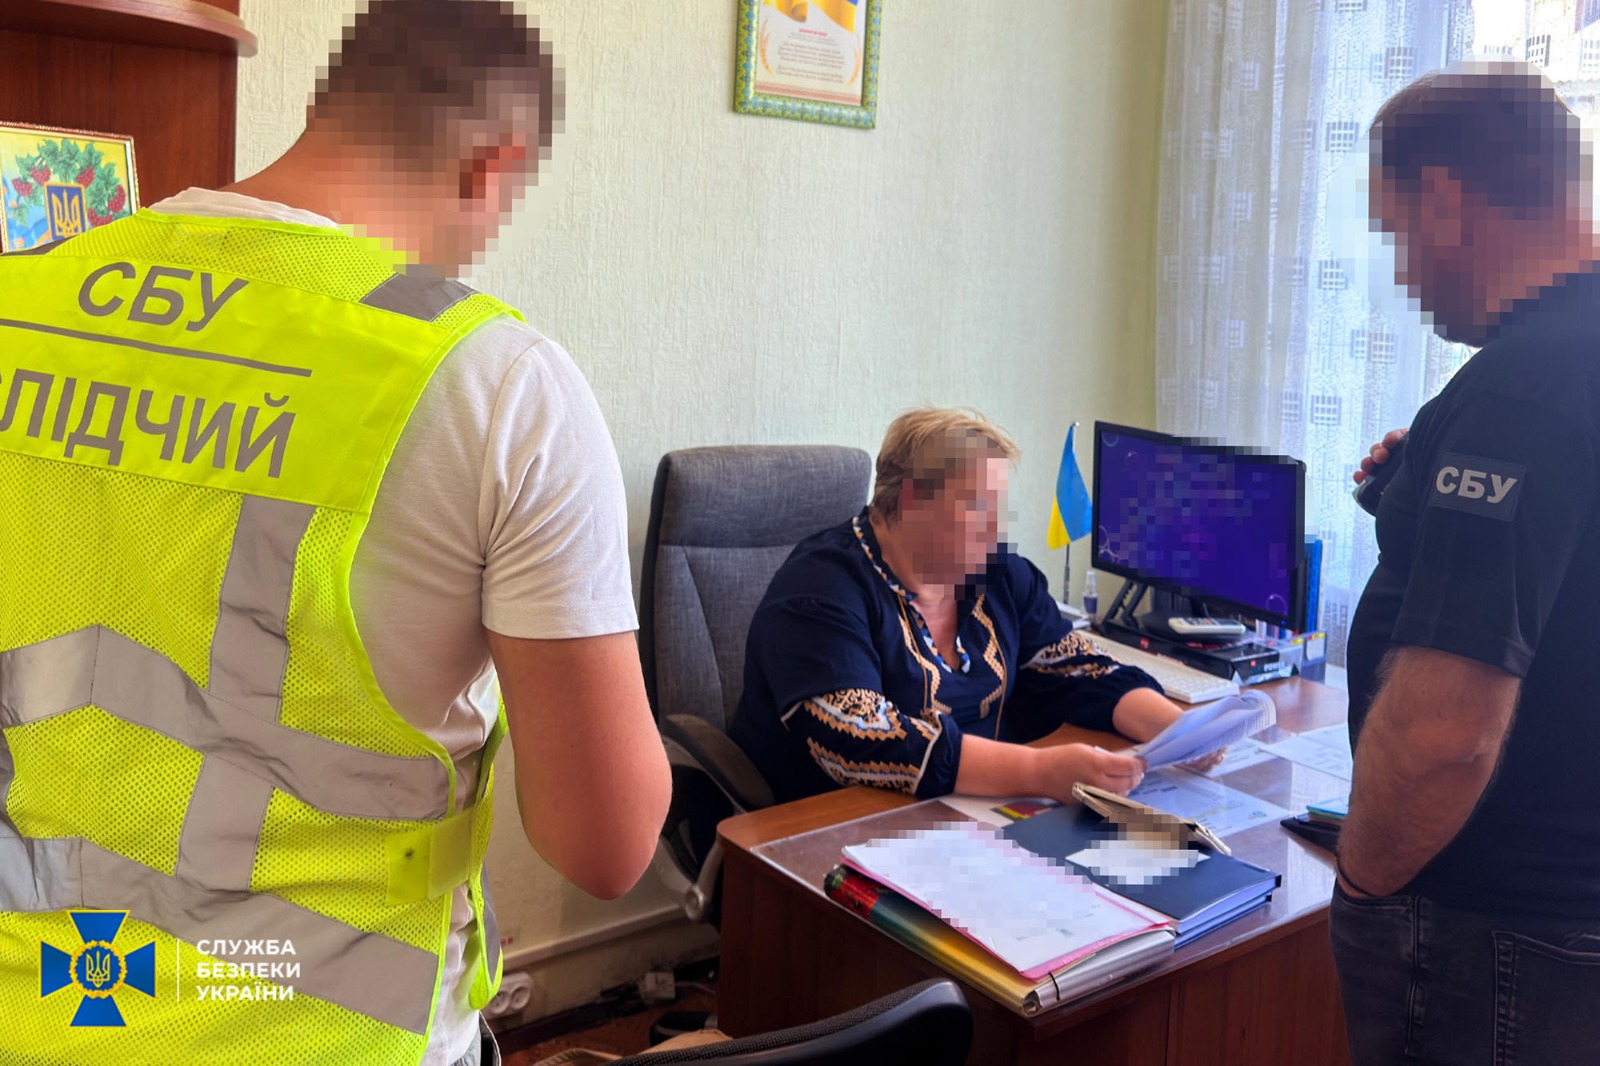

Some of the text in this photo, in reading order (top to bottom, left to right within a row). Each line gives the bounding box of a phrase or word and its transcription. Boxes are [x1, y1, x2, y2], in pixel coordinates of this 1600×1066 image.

[78, 262, 249, 332] СБУ
[0, 369, 296, 479] ЛІДЧИЙ
[1435, 466, 1518, 504] СБУ
